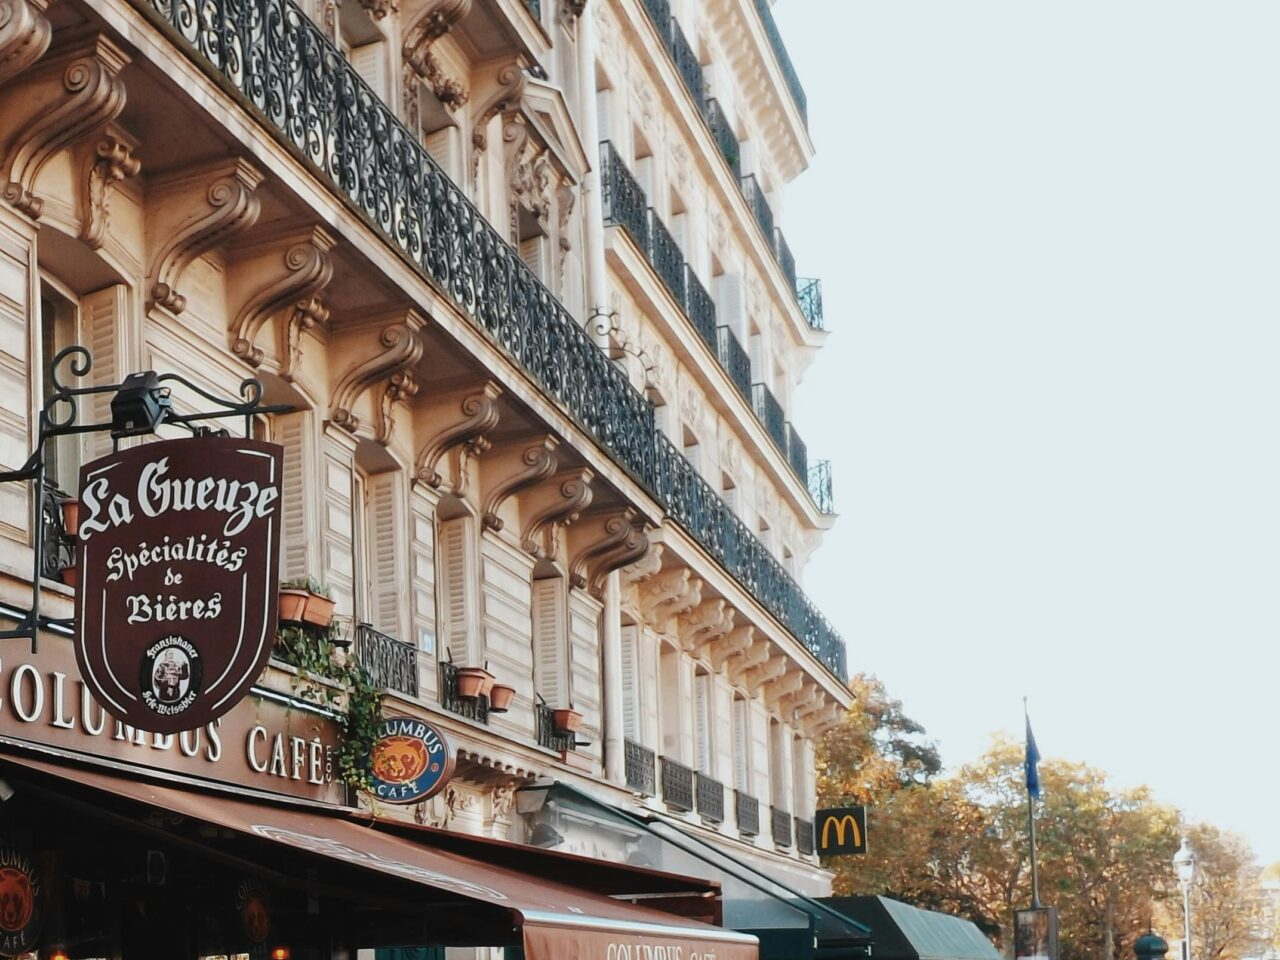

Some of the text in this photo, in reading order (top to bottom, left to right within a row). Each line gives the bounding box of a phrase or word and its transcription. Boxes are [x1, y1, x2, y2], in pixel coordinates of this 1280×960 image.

[79, 456, 279, 541] La Gueuze
[106, 533, 248, 583] Spécialités
[164, 567, 183, 586] de
[126, 592, 222, 625] Bières
[248, 725, 324, 785] CAFÉ
[372, 720, 444, 755] LUMBUS
